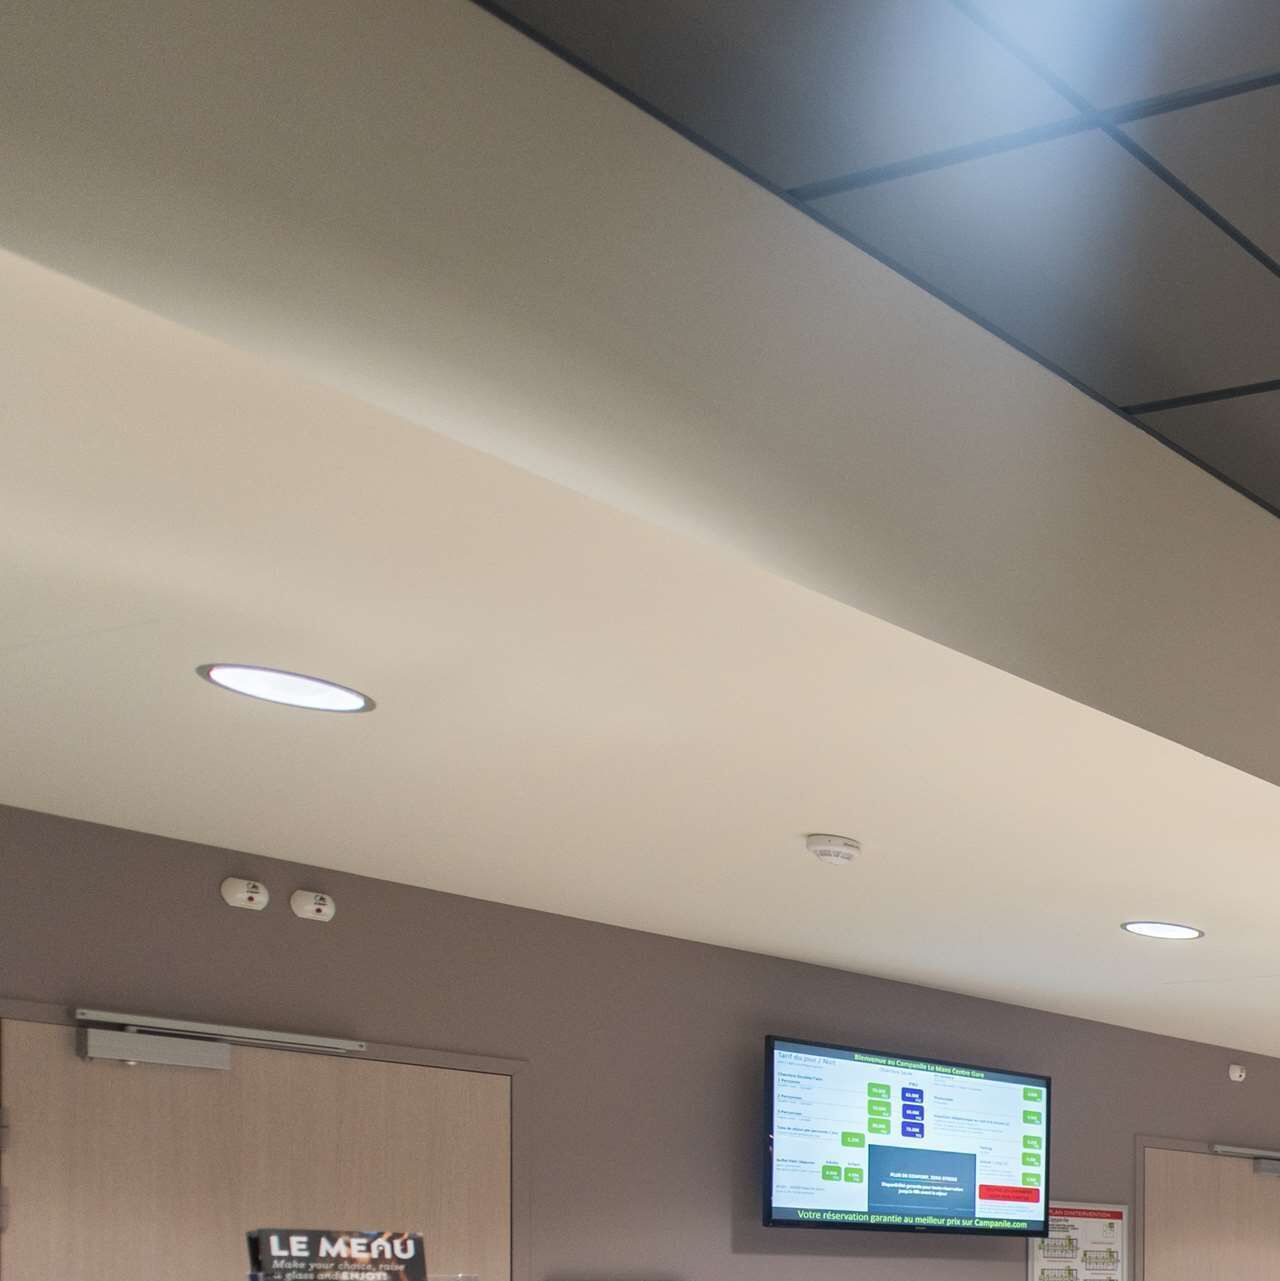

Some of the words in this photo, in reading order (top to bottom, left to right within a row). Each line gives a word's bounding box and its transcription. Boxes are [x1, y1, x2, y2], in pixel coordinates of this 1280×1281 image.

[854, 1053, 887, 1064] Bienvenue
[896, 1060, 927, 1070] Campanile
[935, 1065, 951, 1074] Mans
[952, 1067, 970, 1076] Centre
[971, 1070, 985, 1078] Gare
[797, 1210, 821, 1219] Votre
[823, 1211, 869, 1221] réservation
[870, 1214, 902, 1224] garantie
[914, 1216, 945, 1225] meilleur
[946, 1218, 961, 1227] prix
[974, 1218, 1028, 1229] Campanile.com
[269, 1234, 310, 1258] LE
[319, 1235, 416, 1260] MENU
[272, 1260, 306, 1270] Make
[308, 1261, 334, 1272] your
[337, 1262, 376, 1272] choice,
[285, 1271, 315, 1281] glass
[317, 1271, 339, 1281] and
[339, 1271, 388, 1281] ENJOY!
